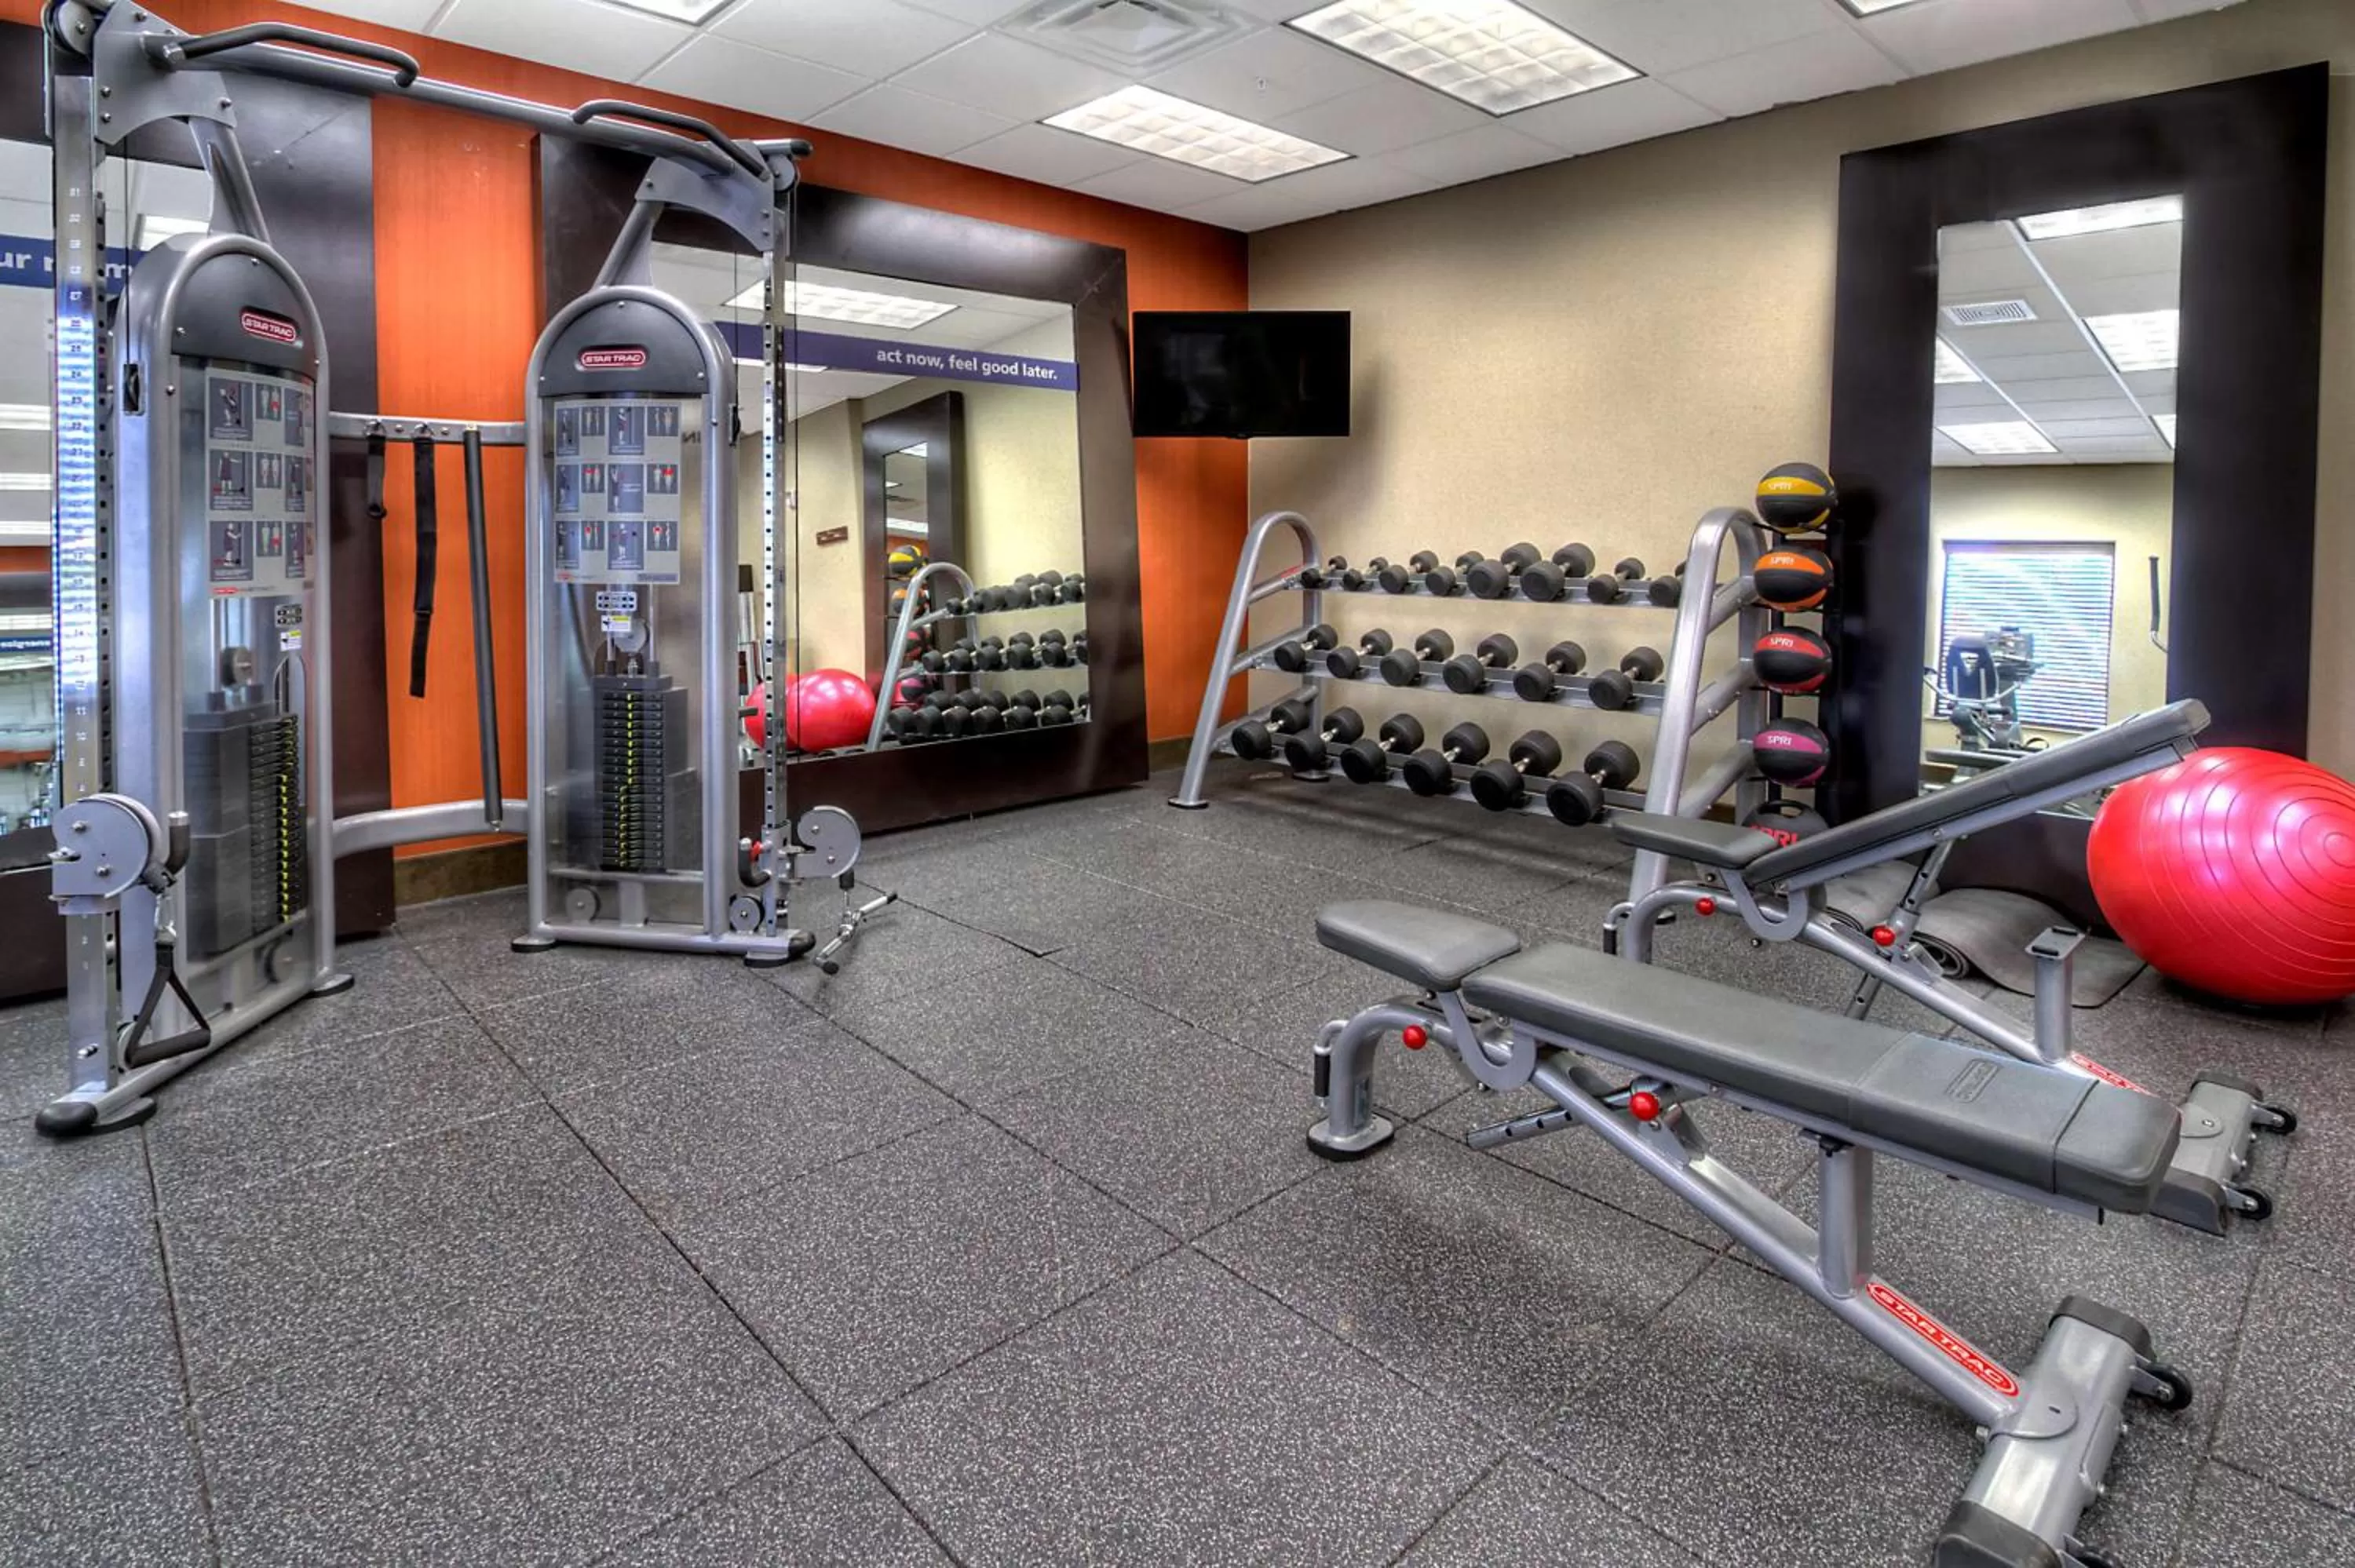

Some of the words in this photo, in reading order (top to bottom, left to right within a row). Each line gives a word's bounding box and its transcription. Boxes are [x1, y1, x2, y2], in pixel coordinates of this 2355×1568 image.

[246, 318, 268, 330] STAR
[269, 325, 292, 337] TRAC
[877, 350, 902, 363] act
[907, 353, 944, 370] now,
[948, 355, 977, 371] feel
[982, 361, 1018, 376] good
[1023, 363, 1057, 380] later.
[1880, 1291, 1937, 1335] STAR
[1941, 1336, 2003, 1383] TRAC
